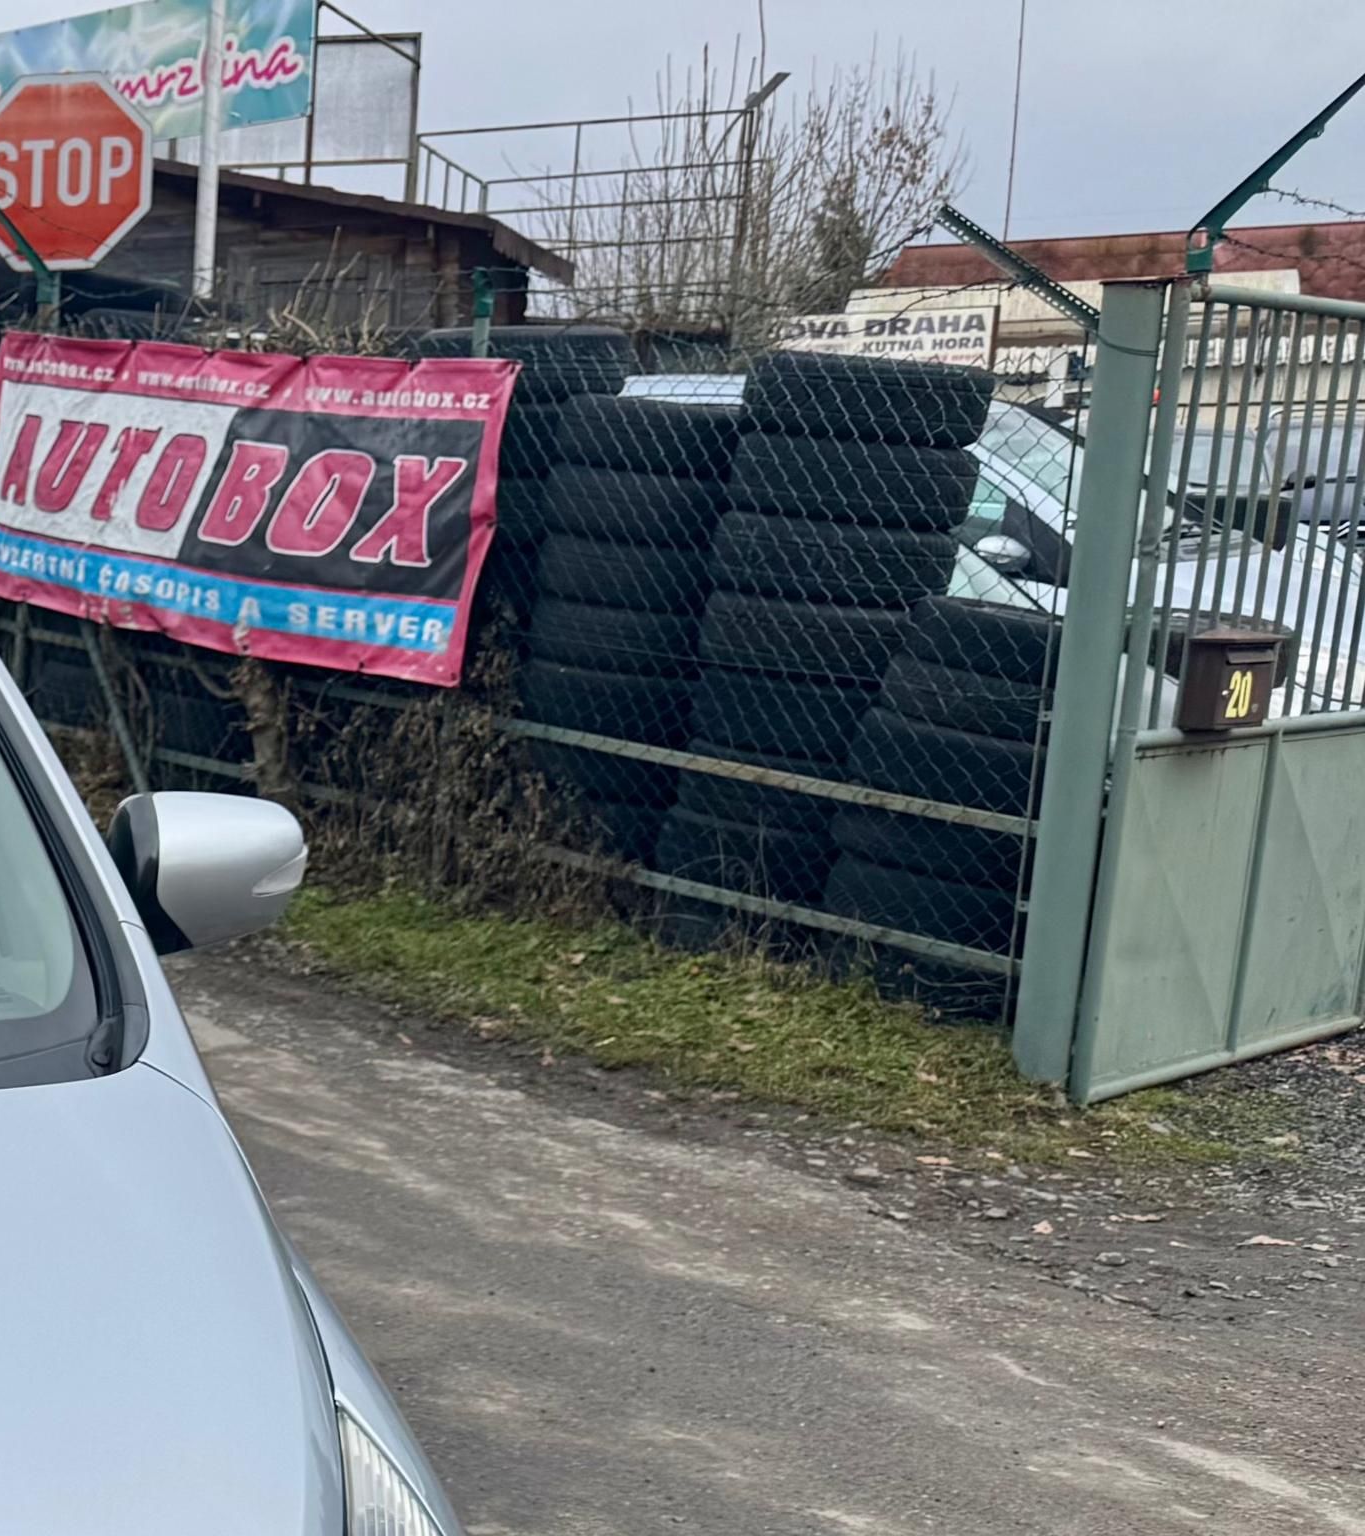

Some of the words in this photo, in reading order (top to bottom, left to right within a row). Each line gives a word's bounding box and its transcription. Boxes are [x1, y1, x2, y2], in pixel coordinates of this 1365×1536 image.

[931, 337, 985, 350] HORA
[0, 413, 468, 568] AUTOBOX
[236, 597, 261, 627] A
[288, 602, 445, 643] SERVER
[1225, 670, 1253, 718] 20
